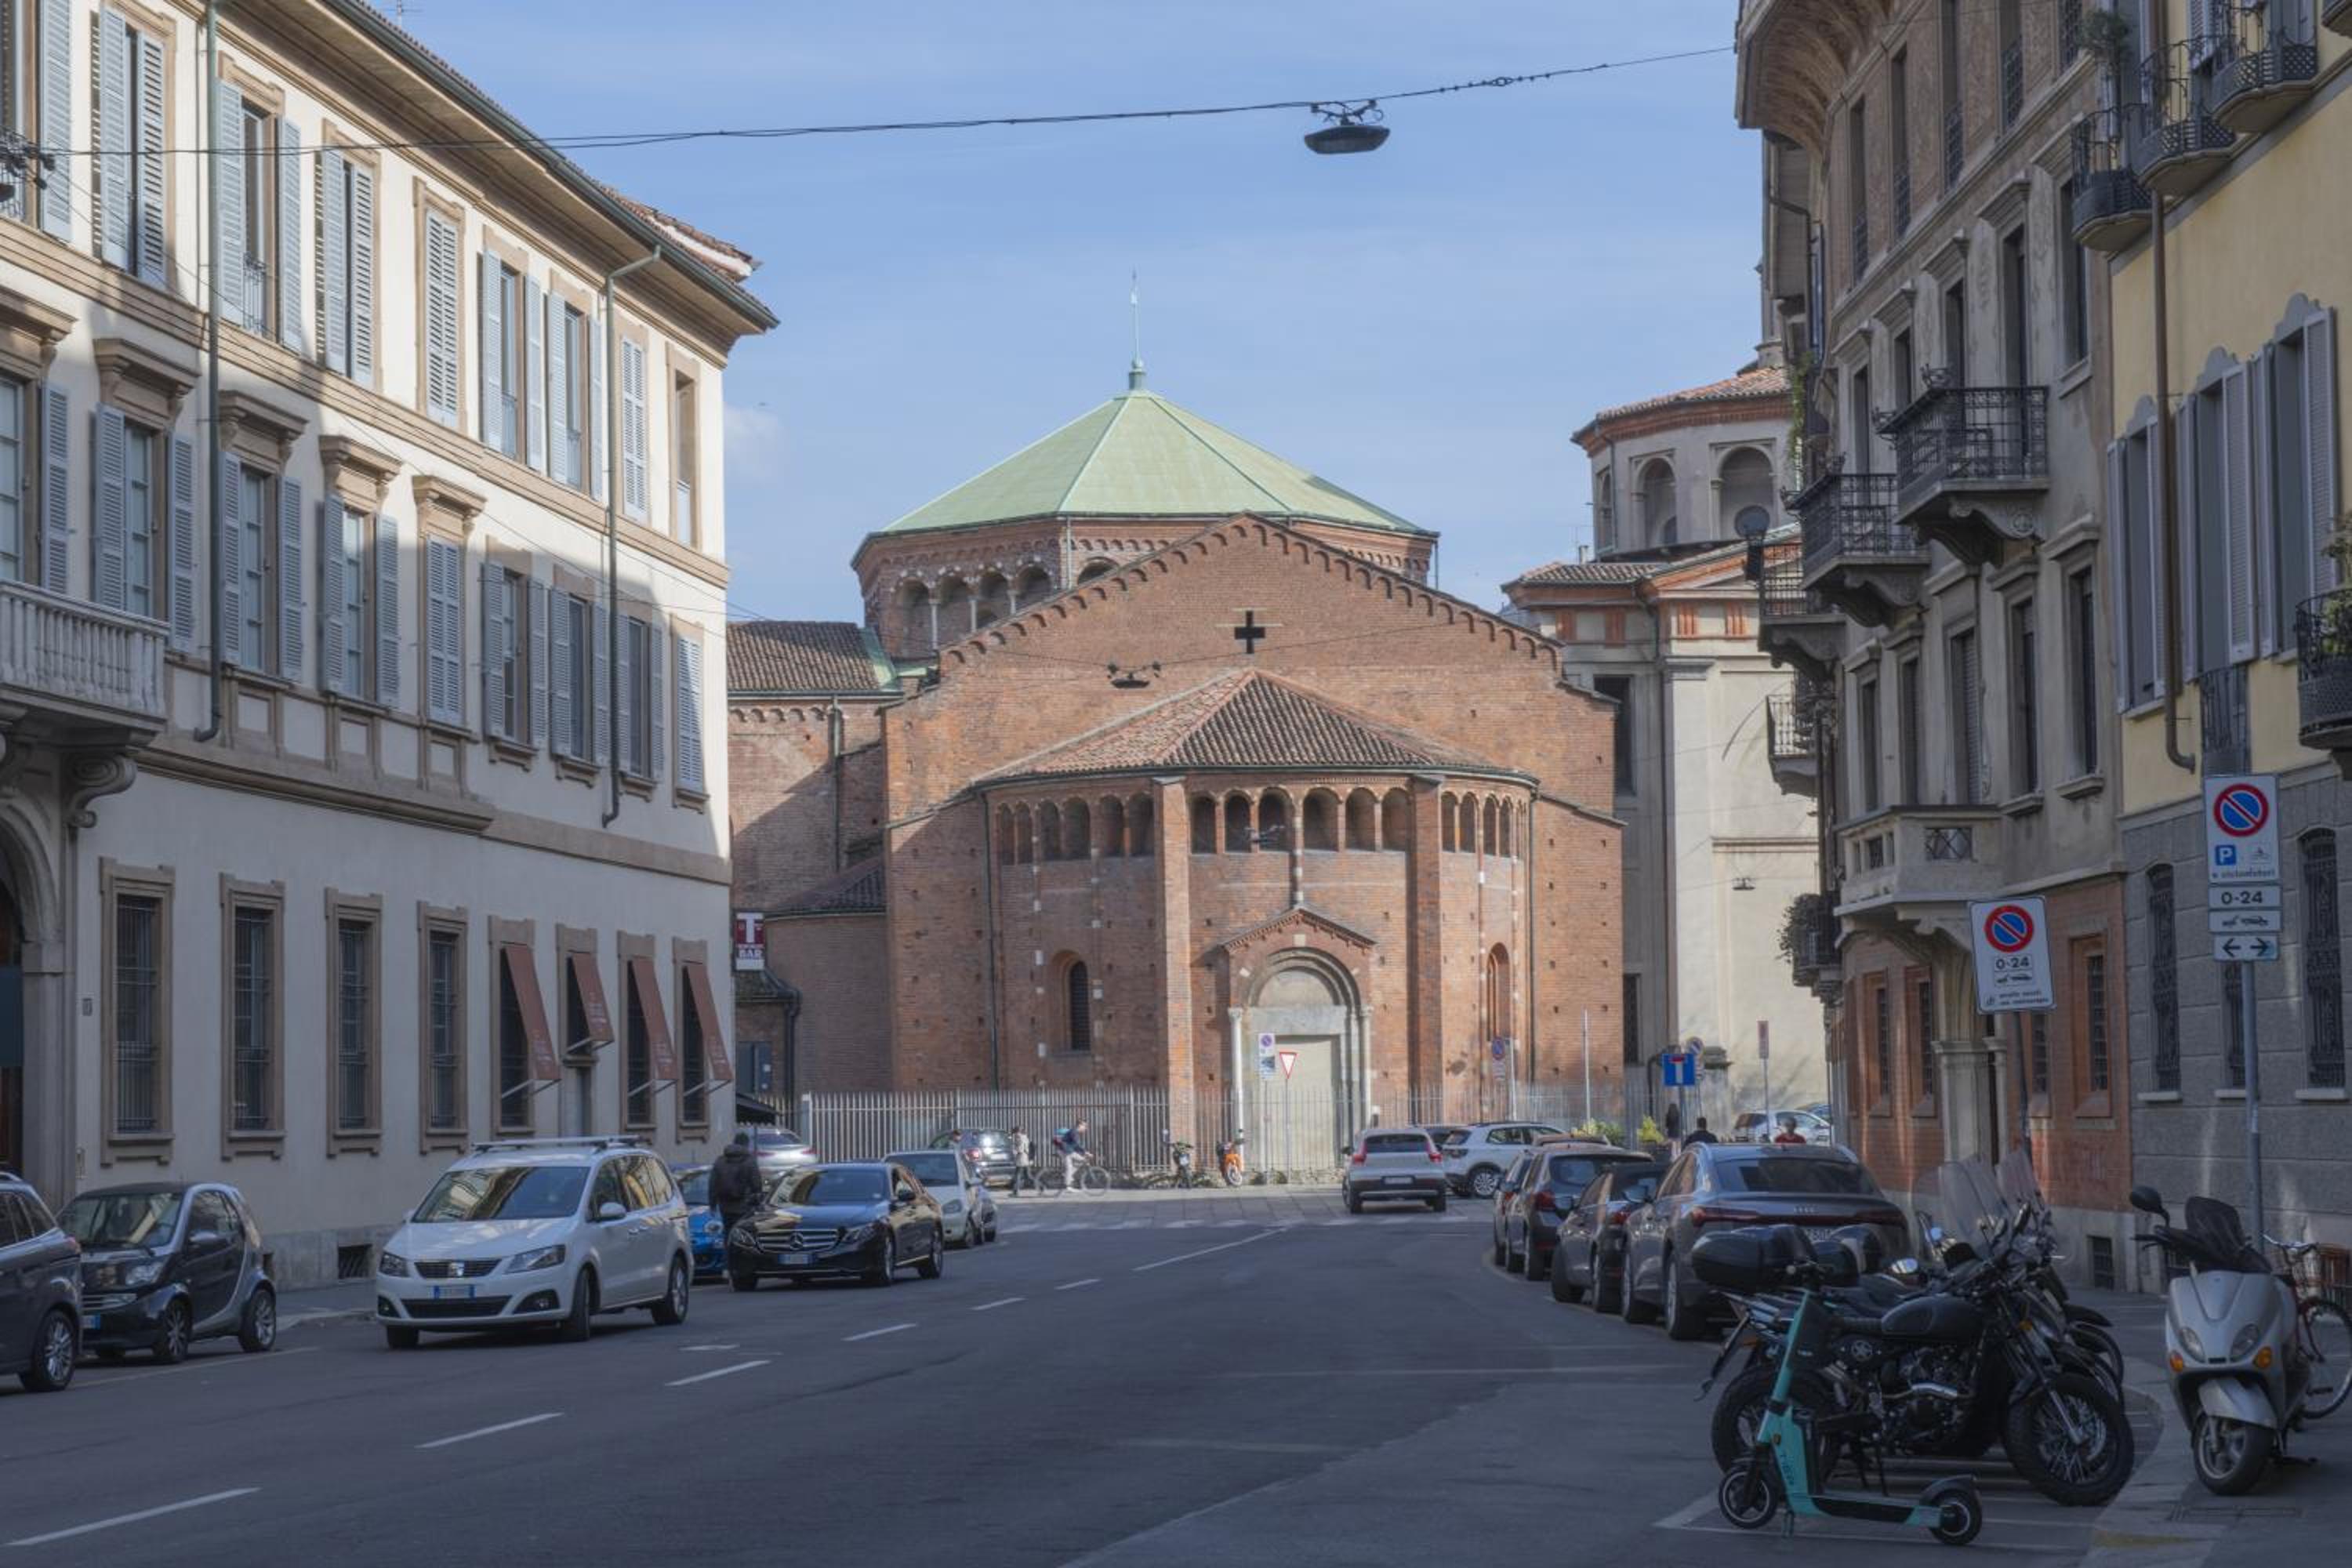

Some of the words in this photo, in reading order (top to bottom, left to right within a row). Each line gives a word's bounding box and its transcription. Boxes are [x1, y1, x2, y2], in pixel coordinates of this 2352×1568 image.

[2219, 848, 2233, 863] P
[2221, 891, 2263, 905] 0-24
[736, 913, 764, 943] T
[739, 949, 763, 959] BAR
